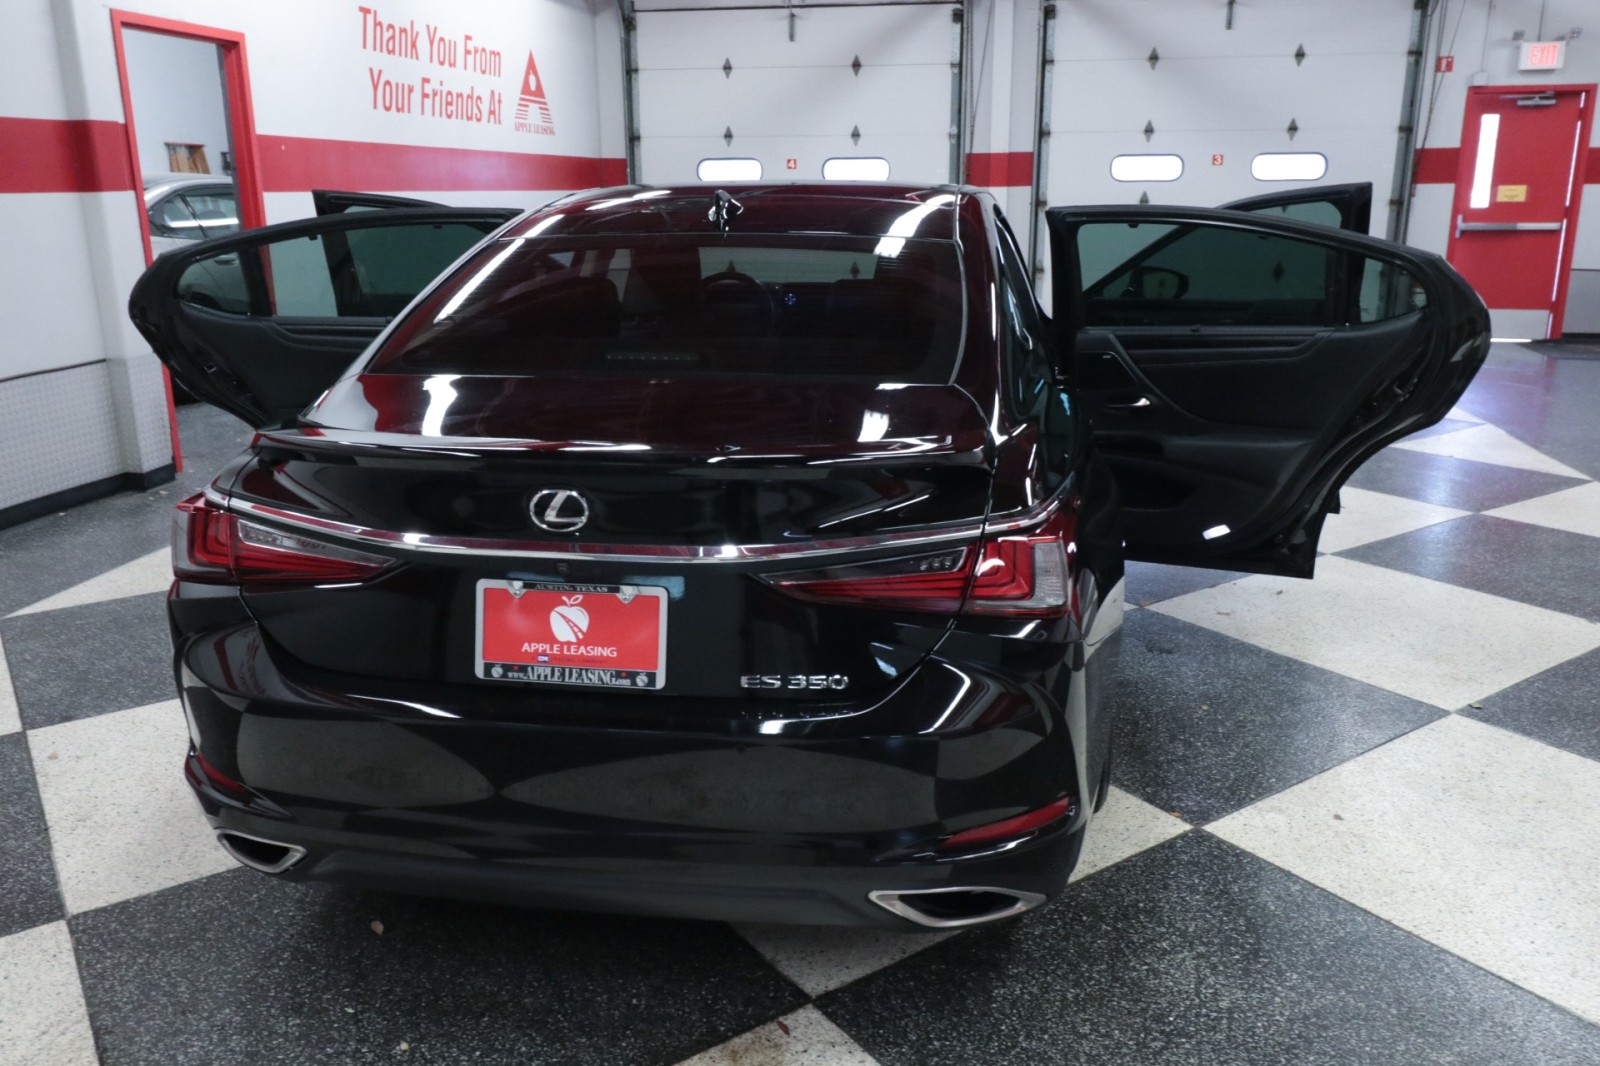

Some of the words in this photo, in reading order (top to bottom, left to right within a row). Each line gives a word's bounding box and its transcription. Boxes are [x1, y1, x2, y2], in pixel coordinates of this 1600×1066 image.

[358, 6, 419, 61] Thank
[426, 24, 457, 68] You
[464, 34, 501, 78] From
[1530, 43, 1560, 66] EXIT
[369, 67, 414, 115] Your
[421, 77, 483, 123] Friends
[487, 90, 502, 125] At
[514, 121, 532, 133] APPLE
[533, 123, 555, 136] LEASING
[787, 159, 796, 169] 4
[1213, 155, 1223, 165] 3
[575, 585, 608, 593] TEXAS
[521, 642, 560, 655] APPLE
[563, 645, 617, 657] LEASING
[740, 675, 782, 689] ES
[787, 674, 849, 690] 350
